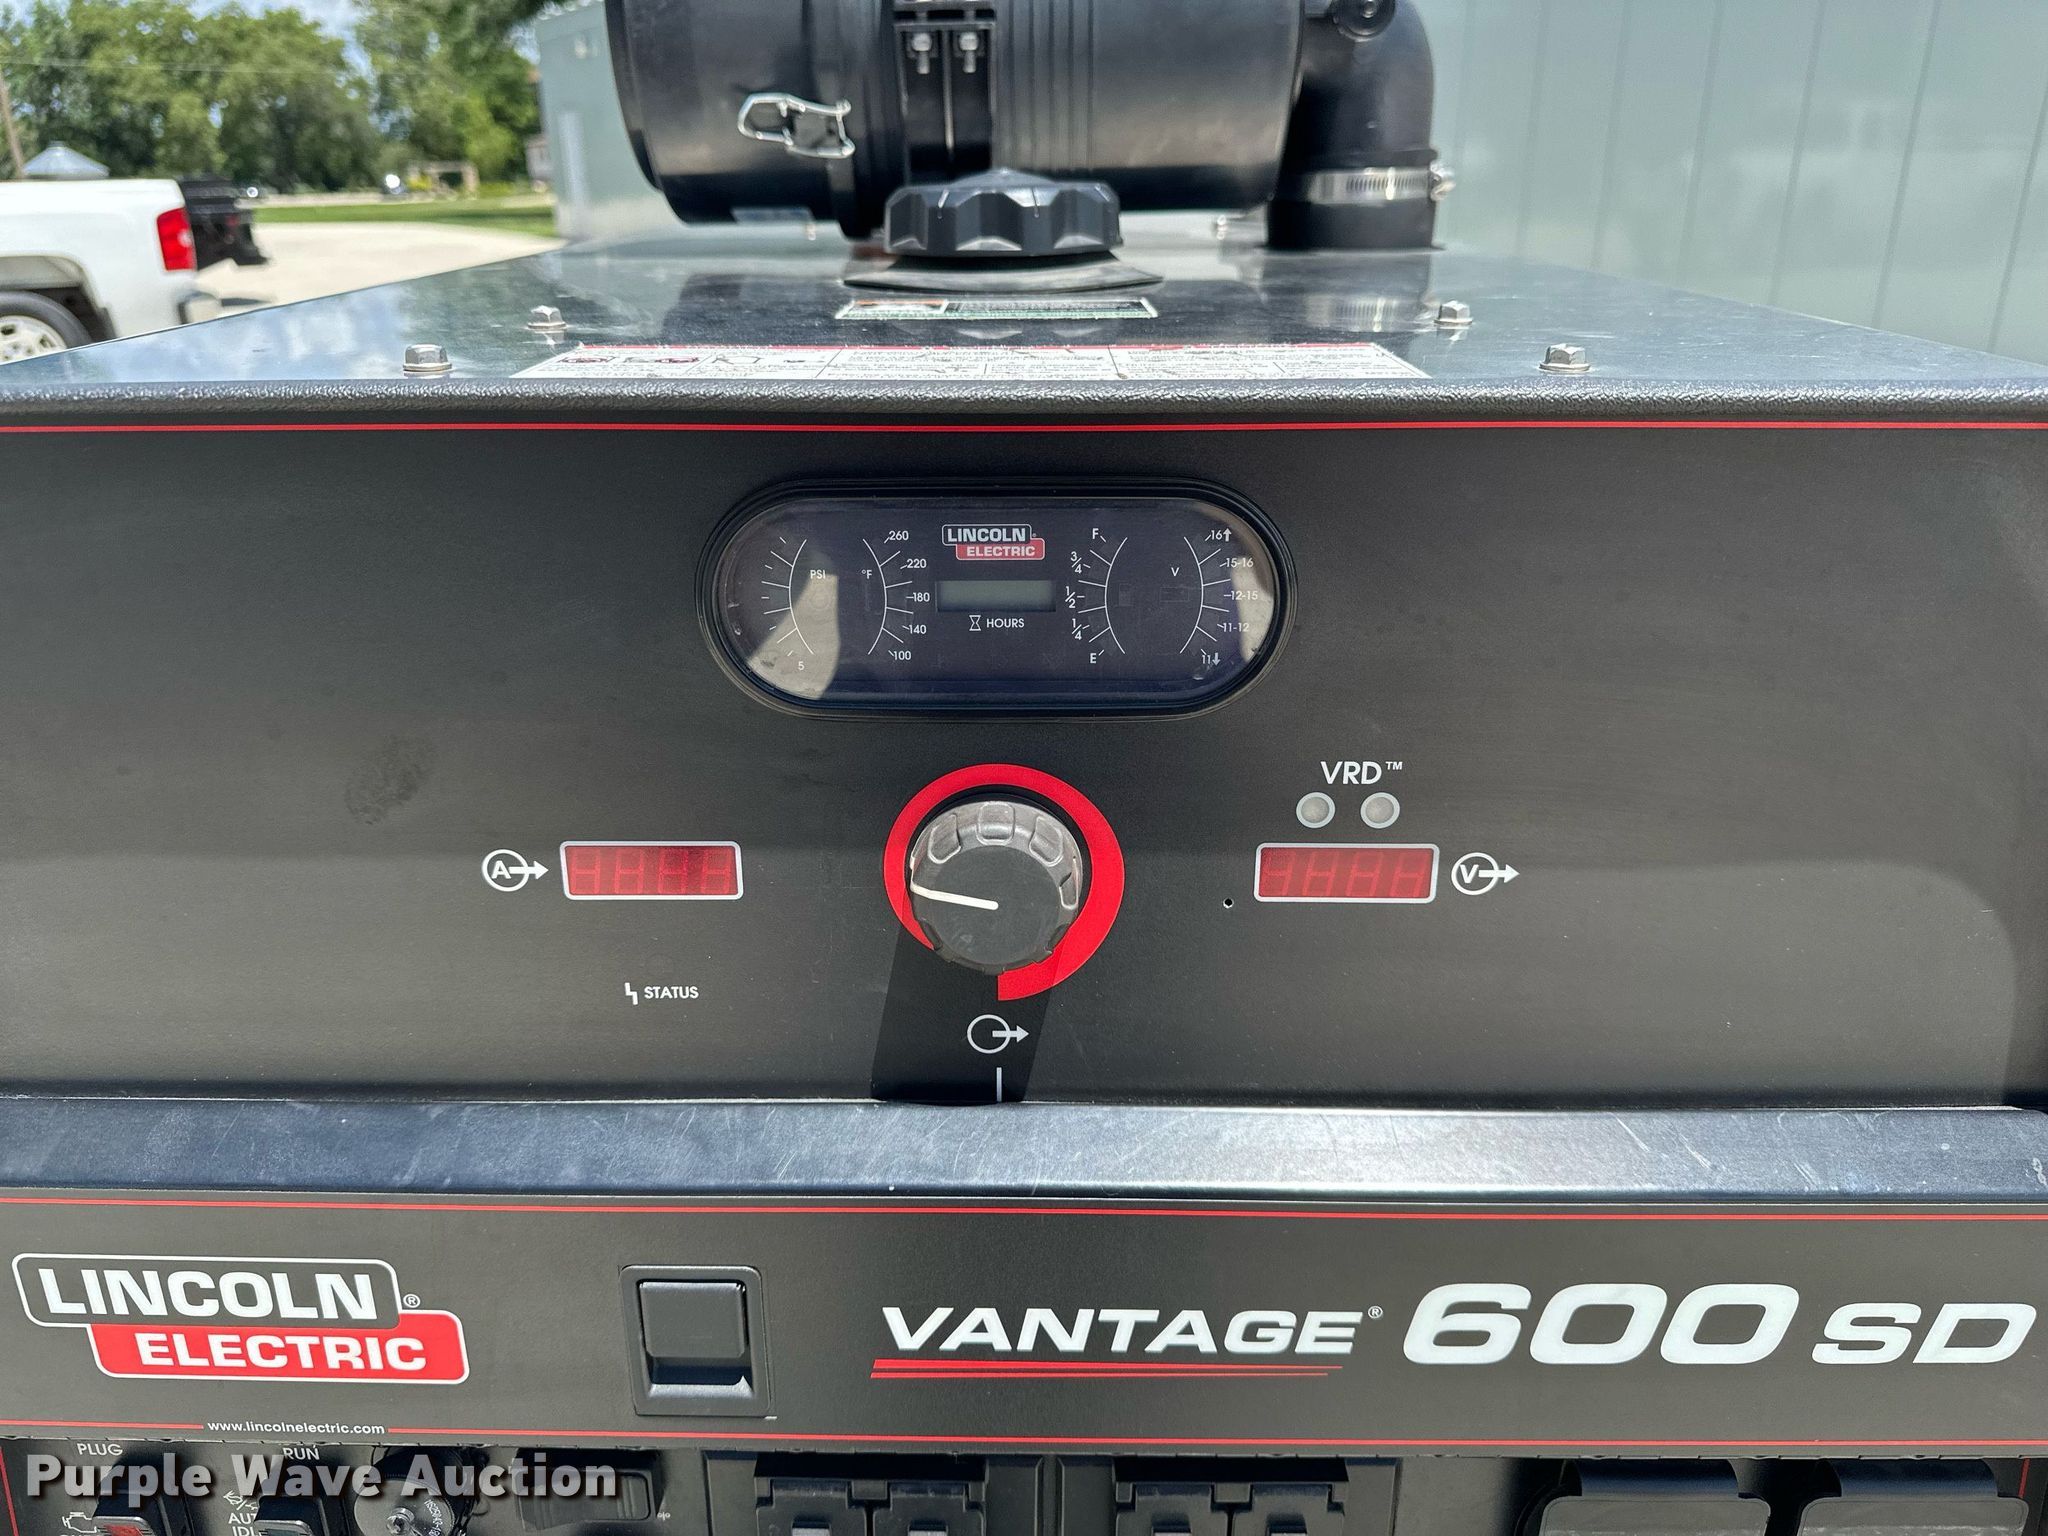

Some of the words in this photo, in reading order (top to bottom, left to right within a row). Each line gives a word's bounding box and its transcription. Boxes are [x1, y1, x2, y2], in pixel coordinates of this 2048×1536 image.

[888, 530, 910, 541] 260
[947, 527, 1026, 542] LINCOLN
[1092, 528, 1099, 540] F
[966, 546, 1035, 557] ELECTRIC
[906, 558, 927, 569] 220
[1225, 557, 1254, 568] 15-16
[809, 569, 827, 580] PSI
[1170, 567, 1180, 577] V
[911, 592, 931, 602] 180
[1230, 590, 1258, 601] 12-15
[986, 618, 1025, 628] HOURS
[1222, 622, 1250, 632] 11-12
[908, 624, 927, 635] 140
[893, 650, 912, 661] 100
[1089, 653, 1097, 664] E
[798, 661, 805, 671] 5
[644, 985, 699, 999] STATUS
[38, 1268, 378, 1321] LINCOLN
[1403, 1282, 1800, 1365] 600
[1811, 1302, 2037, 1365] SD
[134, 1332, 426, 1371] ELECTRIC
[206, 1420, 386, 1436] www.lincolnelectric.com
[77, 1442, 124, 1457] PLUG
[283, 1446, 320, 1461] RUN
